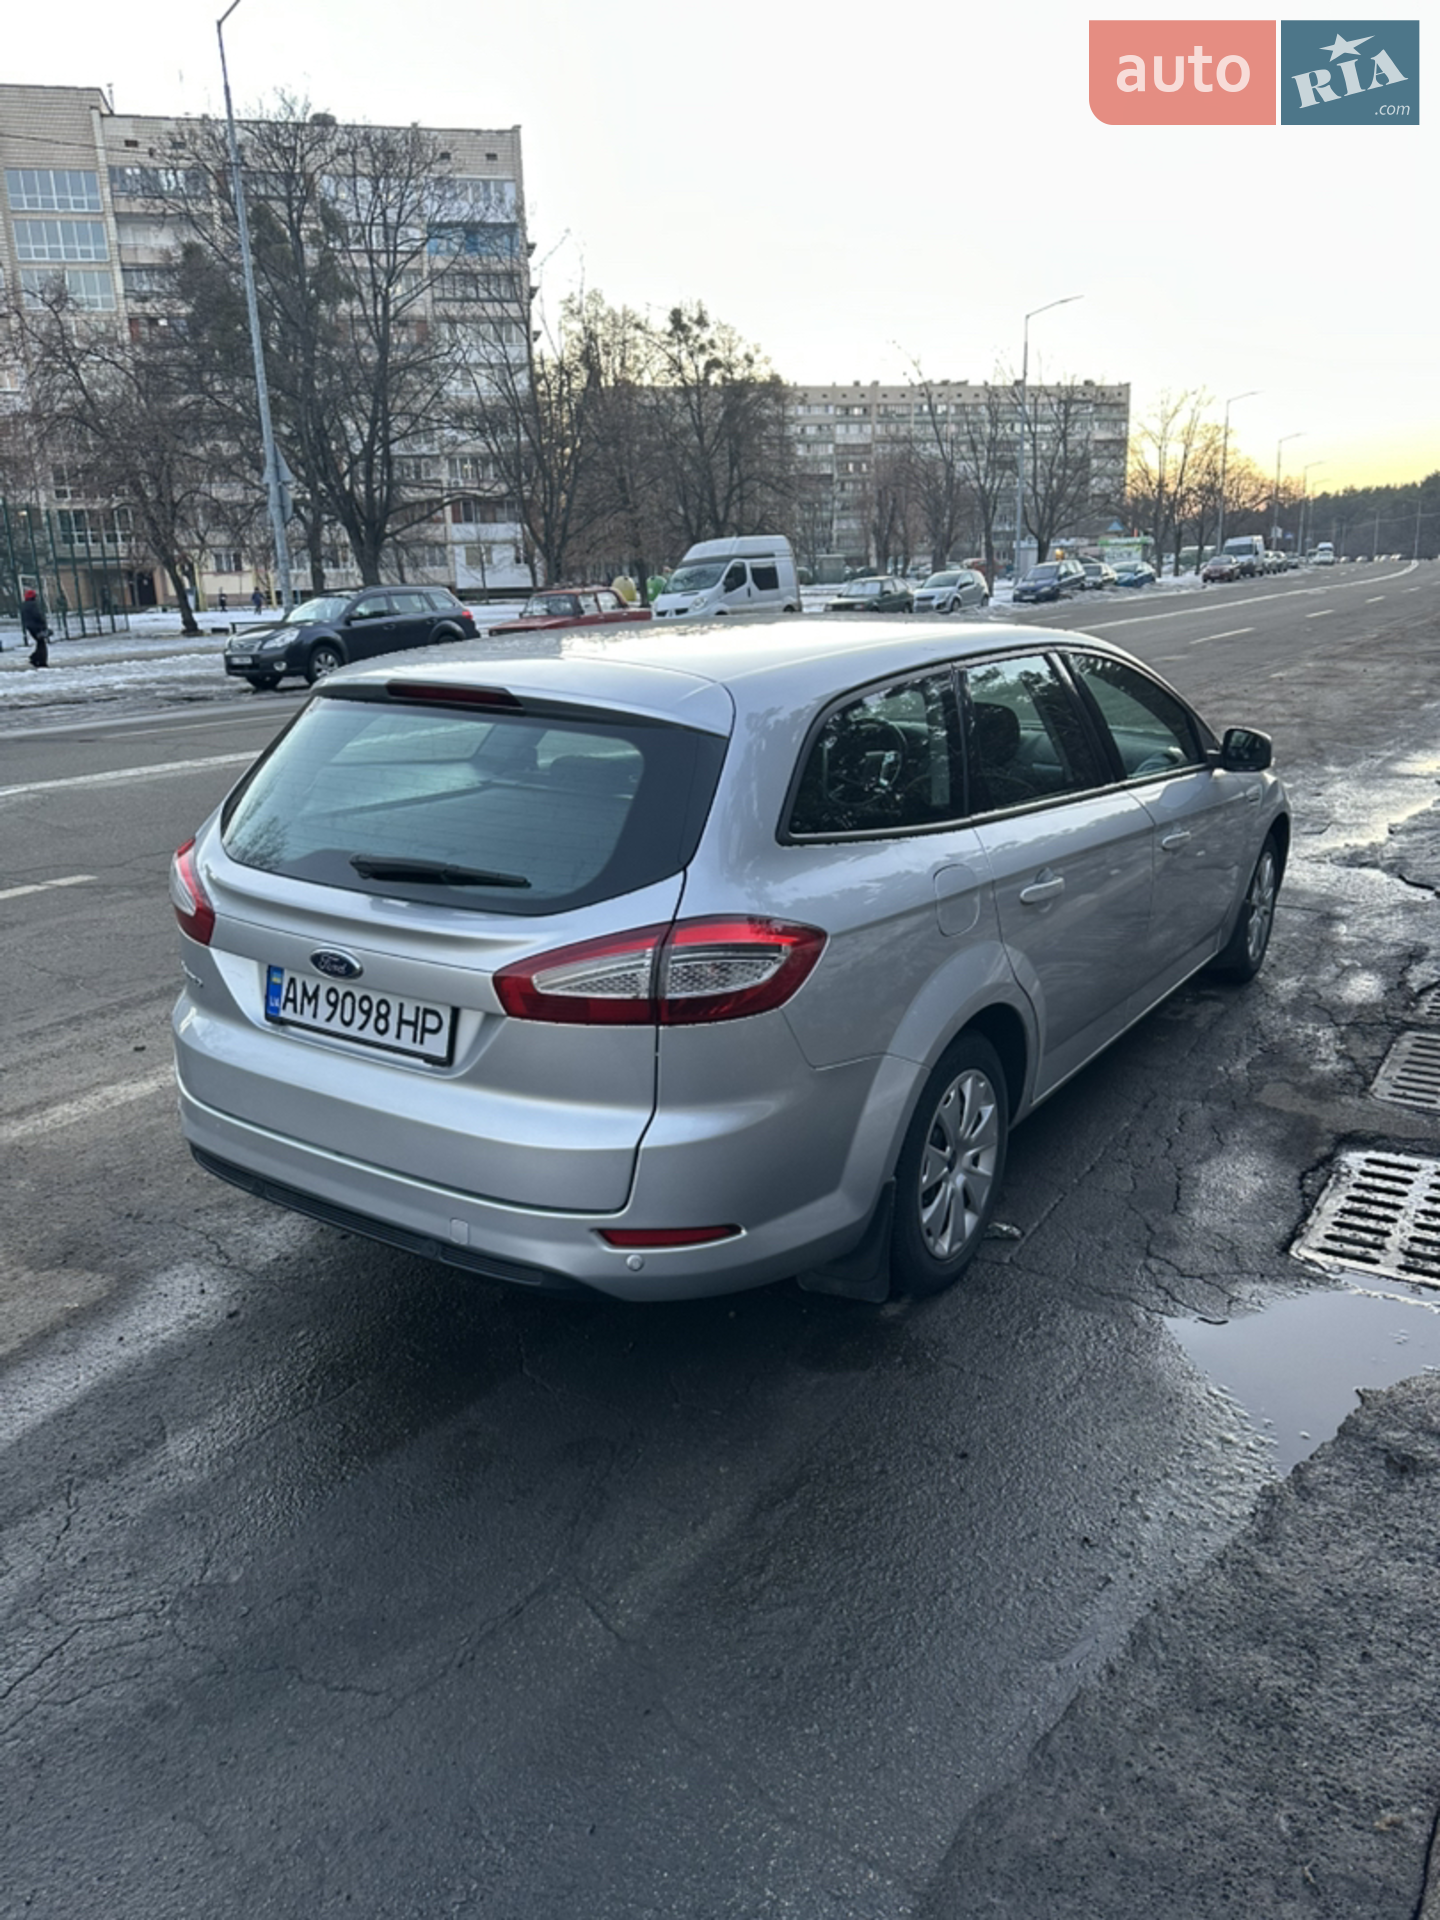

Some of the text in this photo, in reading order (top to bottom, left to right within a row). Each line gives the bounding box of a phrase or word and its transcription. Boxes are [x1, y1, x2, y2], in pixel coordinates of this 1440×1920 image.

[317, 954, 348, 975] Ford
[282, 976, 444, 1046] AM 9098 HP
